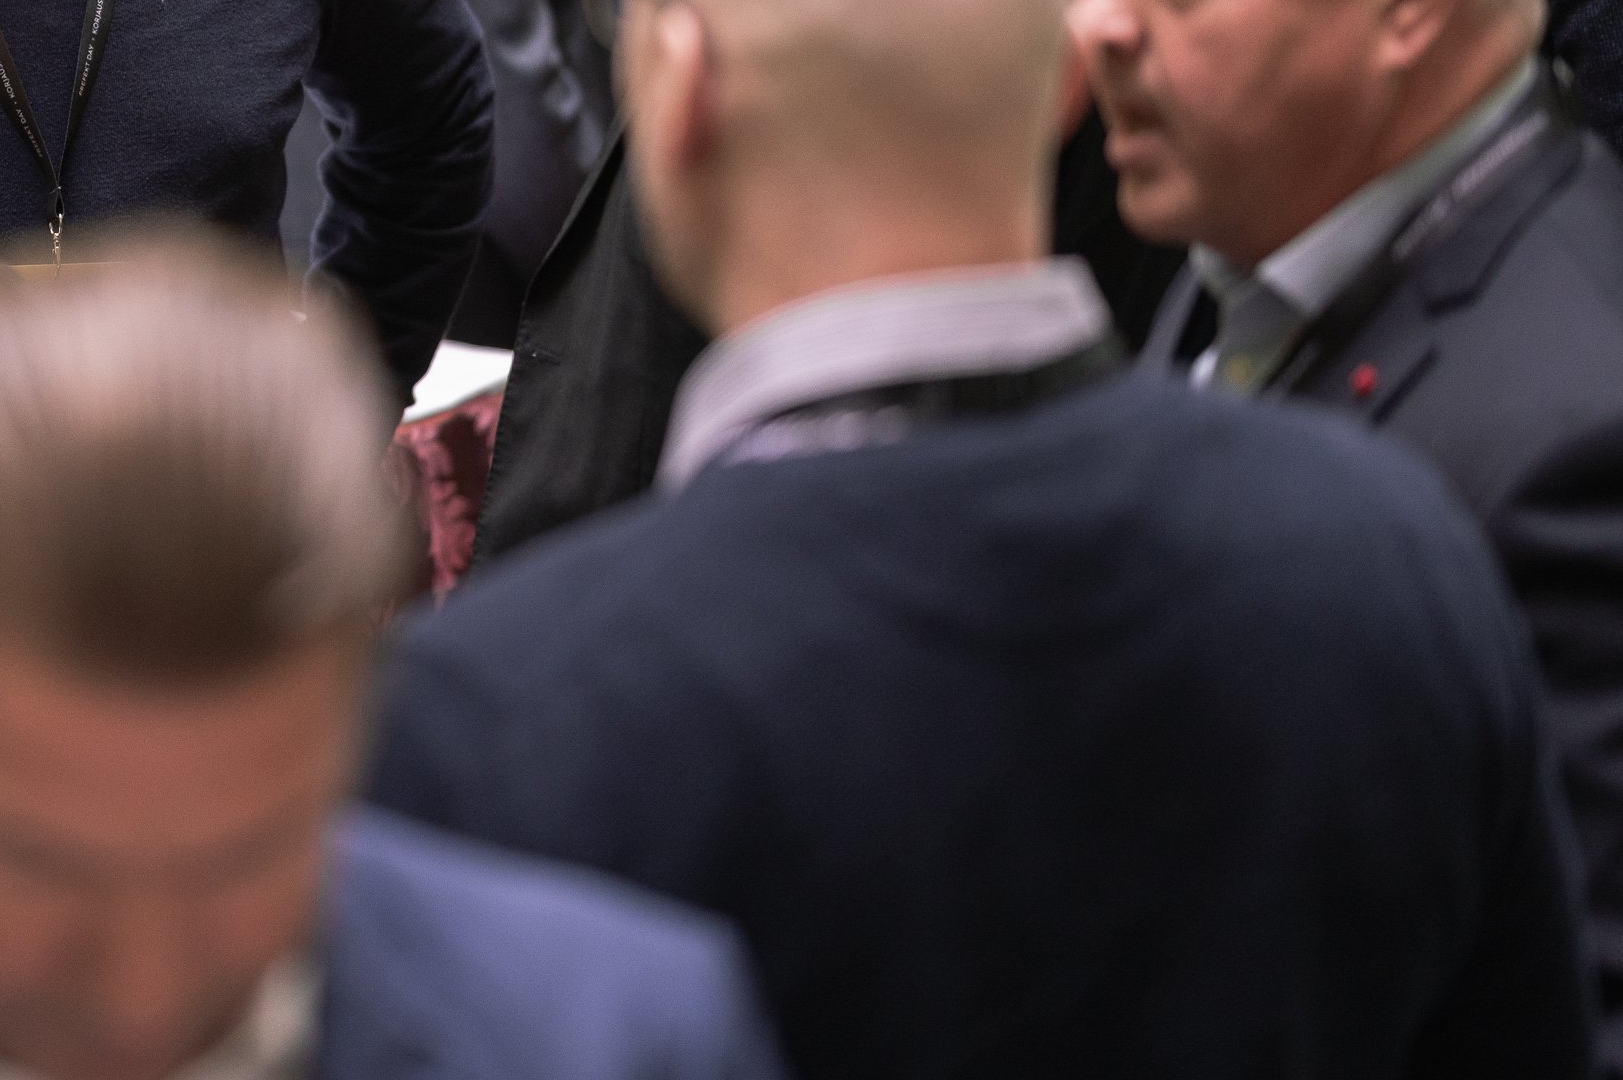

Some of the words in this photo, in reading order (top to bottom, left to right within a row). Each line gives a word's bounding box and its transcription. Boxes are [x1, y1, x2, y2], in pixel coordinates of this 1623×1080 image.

[79, 60, 90, 96] PREFEKT
[86, 43, 95, 61] DAY
[15, 108, 27, 124] DAY
[24, 124, 43, 158] PREFEKT
